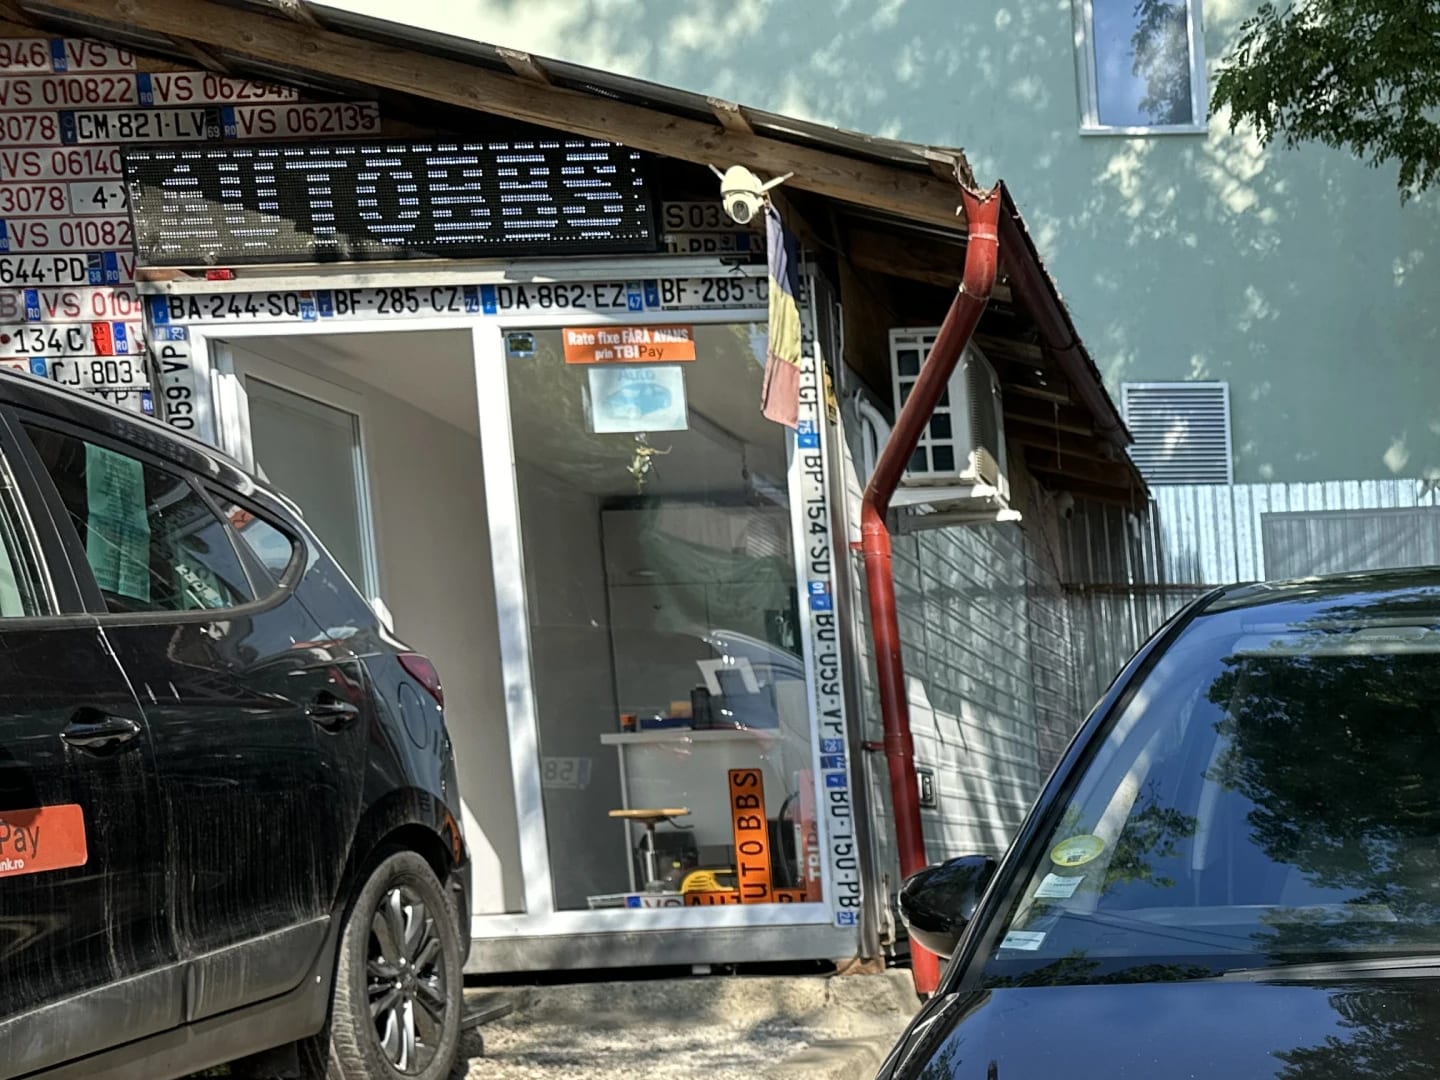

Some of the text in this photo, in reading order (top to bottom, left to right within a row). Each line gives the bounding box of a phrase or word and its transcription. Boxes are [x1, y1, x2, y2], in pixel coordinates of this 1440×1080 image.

[68, 42, 107, 68] VS
[42, 78, 133, 105] 010822
[154, 76, 193, 102] VS
[79, 112, 204, 139] CM-821-LV
[238, 109, 277, 134] VS
[287, 104, 375, 132] 062135
[2, 151, 41, 177] VS
[0, 186, 65, 212] 3078
[10, 222, 49, 248] VS
[59, 221, 133, 247] 01082
[0, 257, 86, 283] 644-PD
[28, 307, 39, 318] RO
[42, 293, 80, 318] VS
[169, 293, 299, 320] BA-244-SQ
[335, 286, 460, 315] BF-285-CZ
[498, 283, 626, 310] DA-862-EZ
[116, 341, 128, 351] RO
[567, 330, 595, 345] Rate
[598, 331, 620, 344] fixe
[653, 328, 689, 342] AVANS
[595, 349, 613, 361] prin
[805, 455, 830, 574] BP-154-SD
